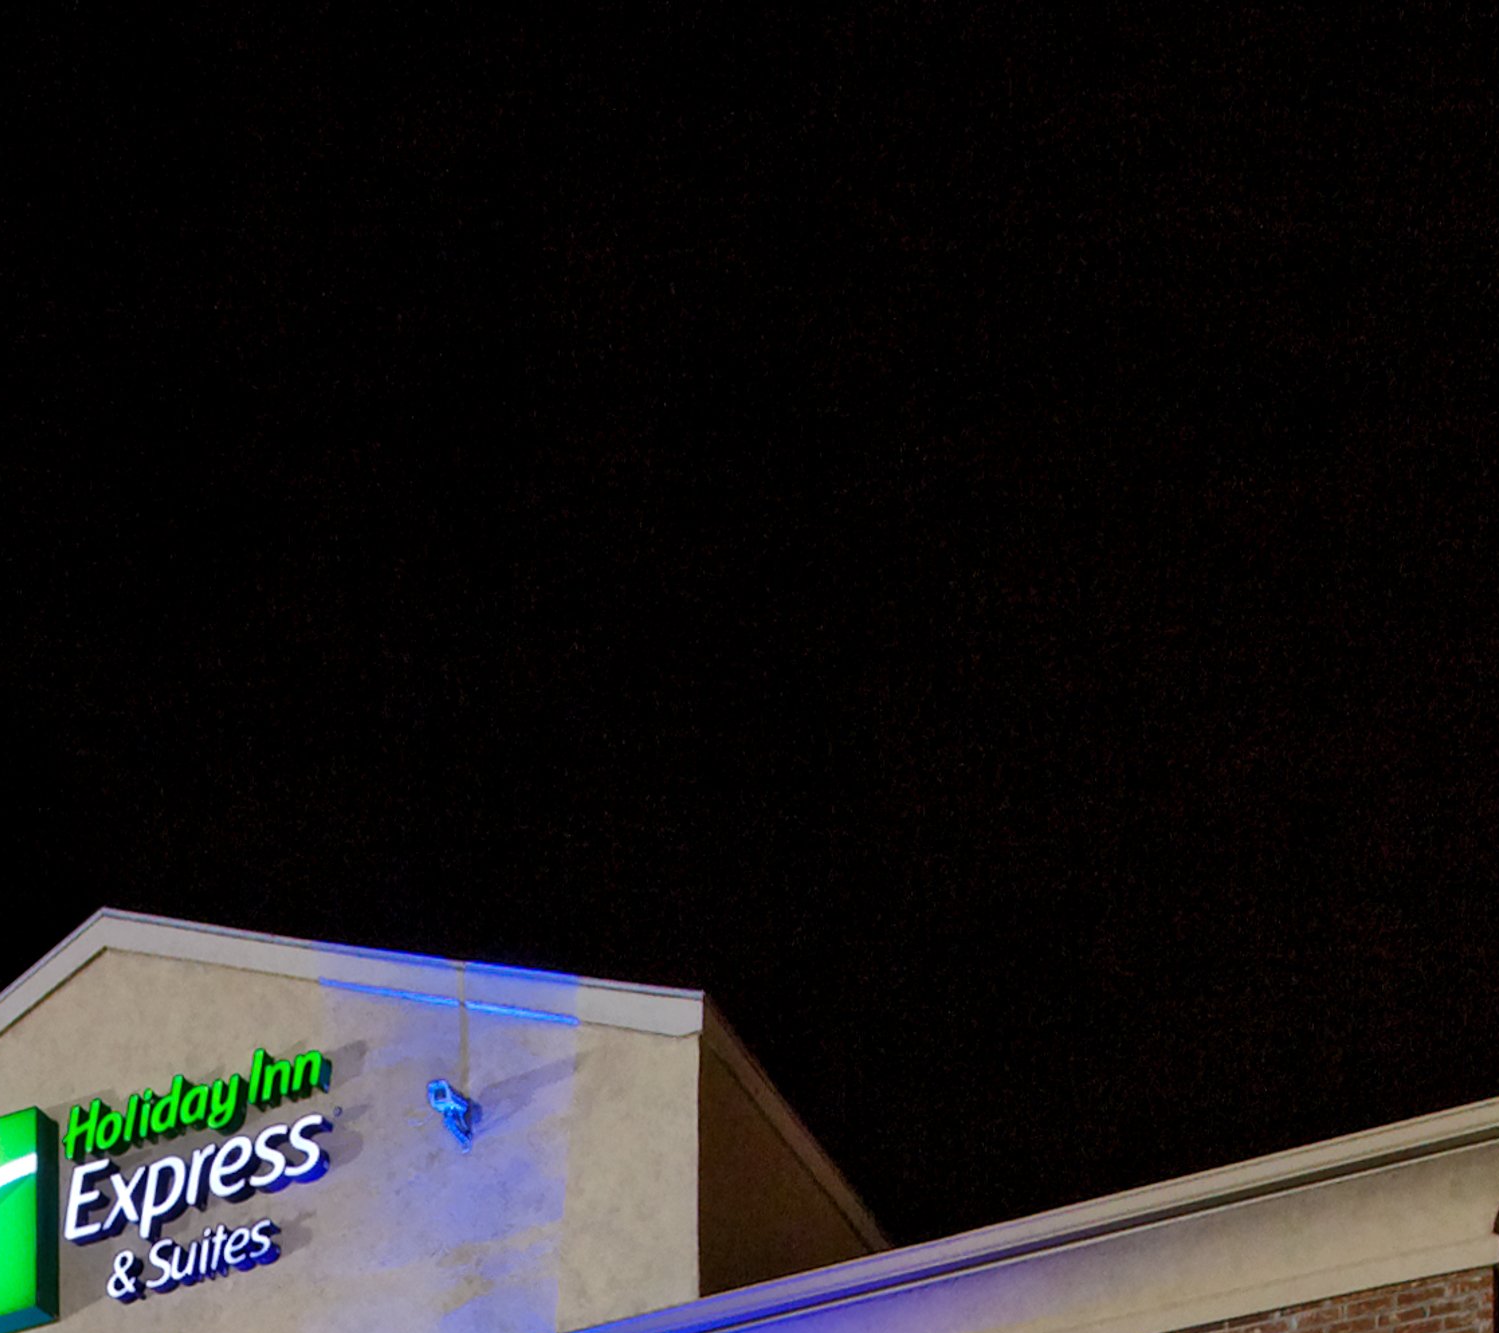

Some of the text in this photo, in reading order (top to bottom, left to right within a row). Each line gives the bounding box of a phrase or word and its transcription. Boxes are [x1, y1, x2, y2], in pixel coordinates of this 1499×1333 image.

[63, 1048, 323, 1159] Holiday Inn
[64, 1115, 324, 1241] Express
[106, 1219, 272, 1299] & Suites
